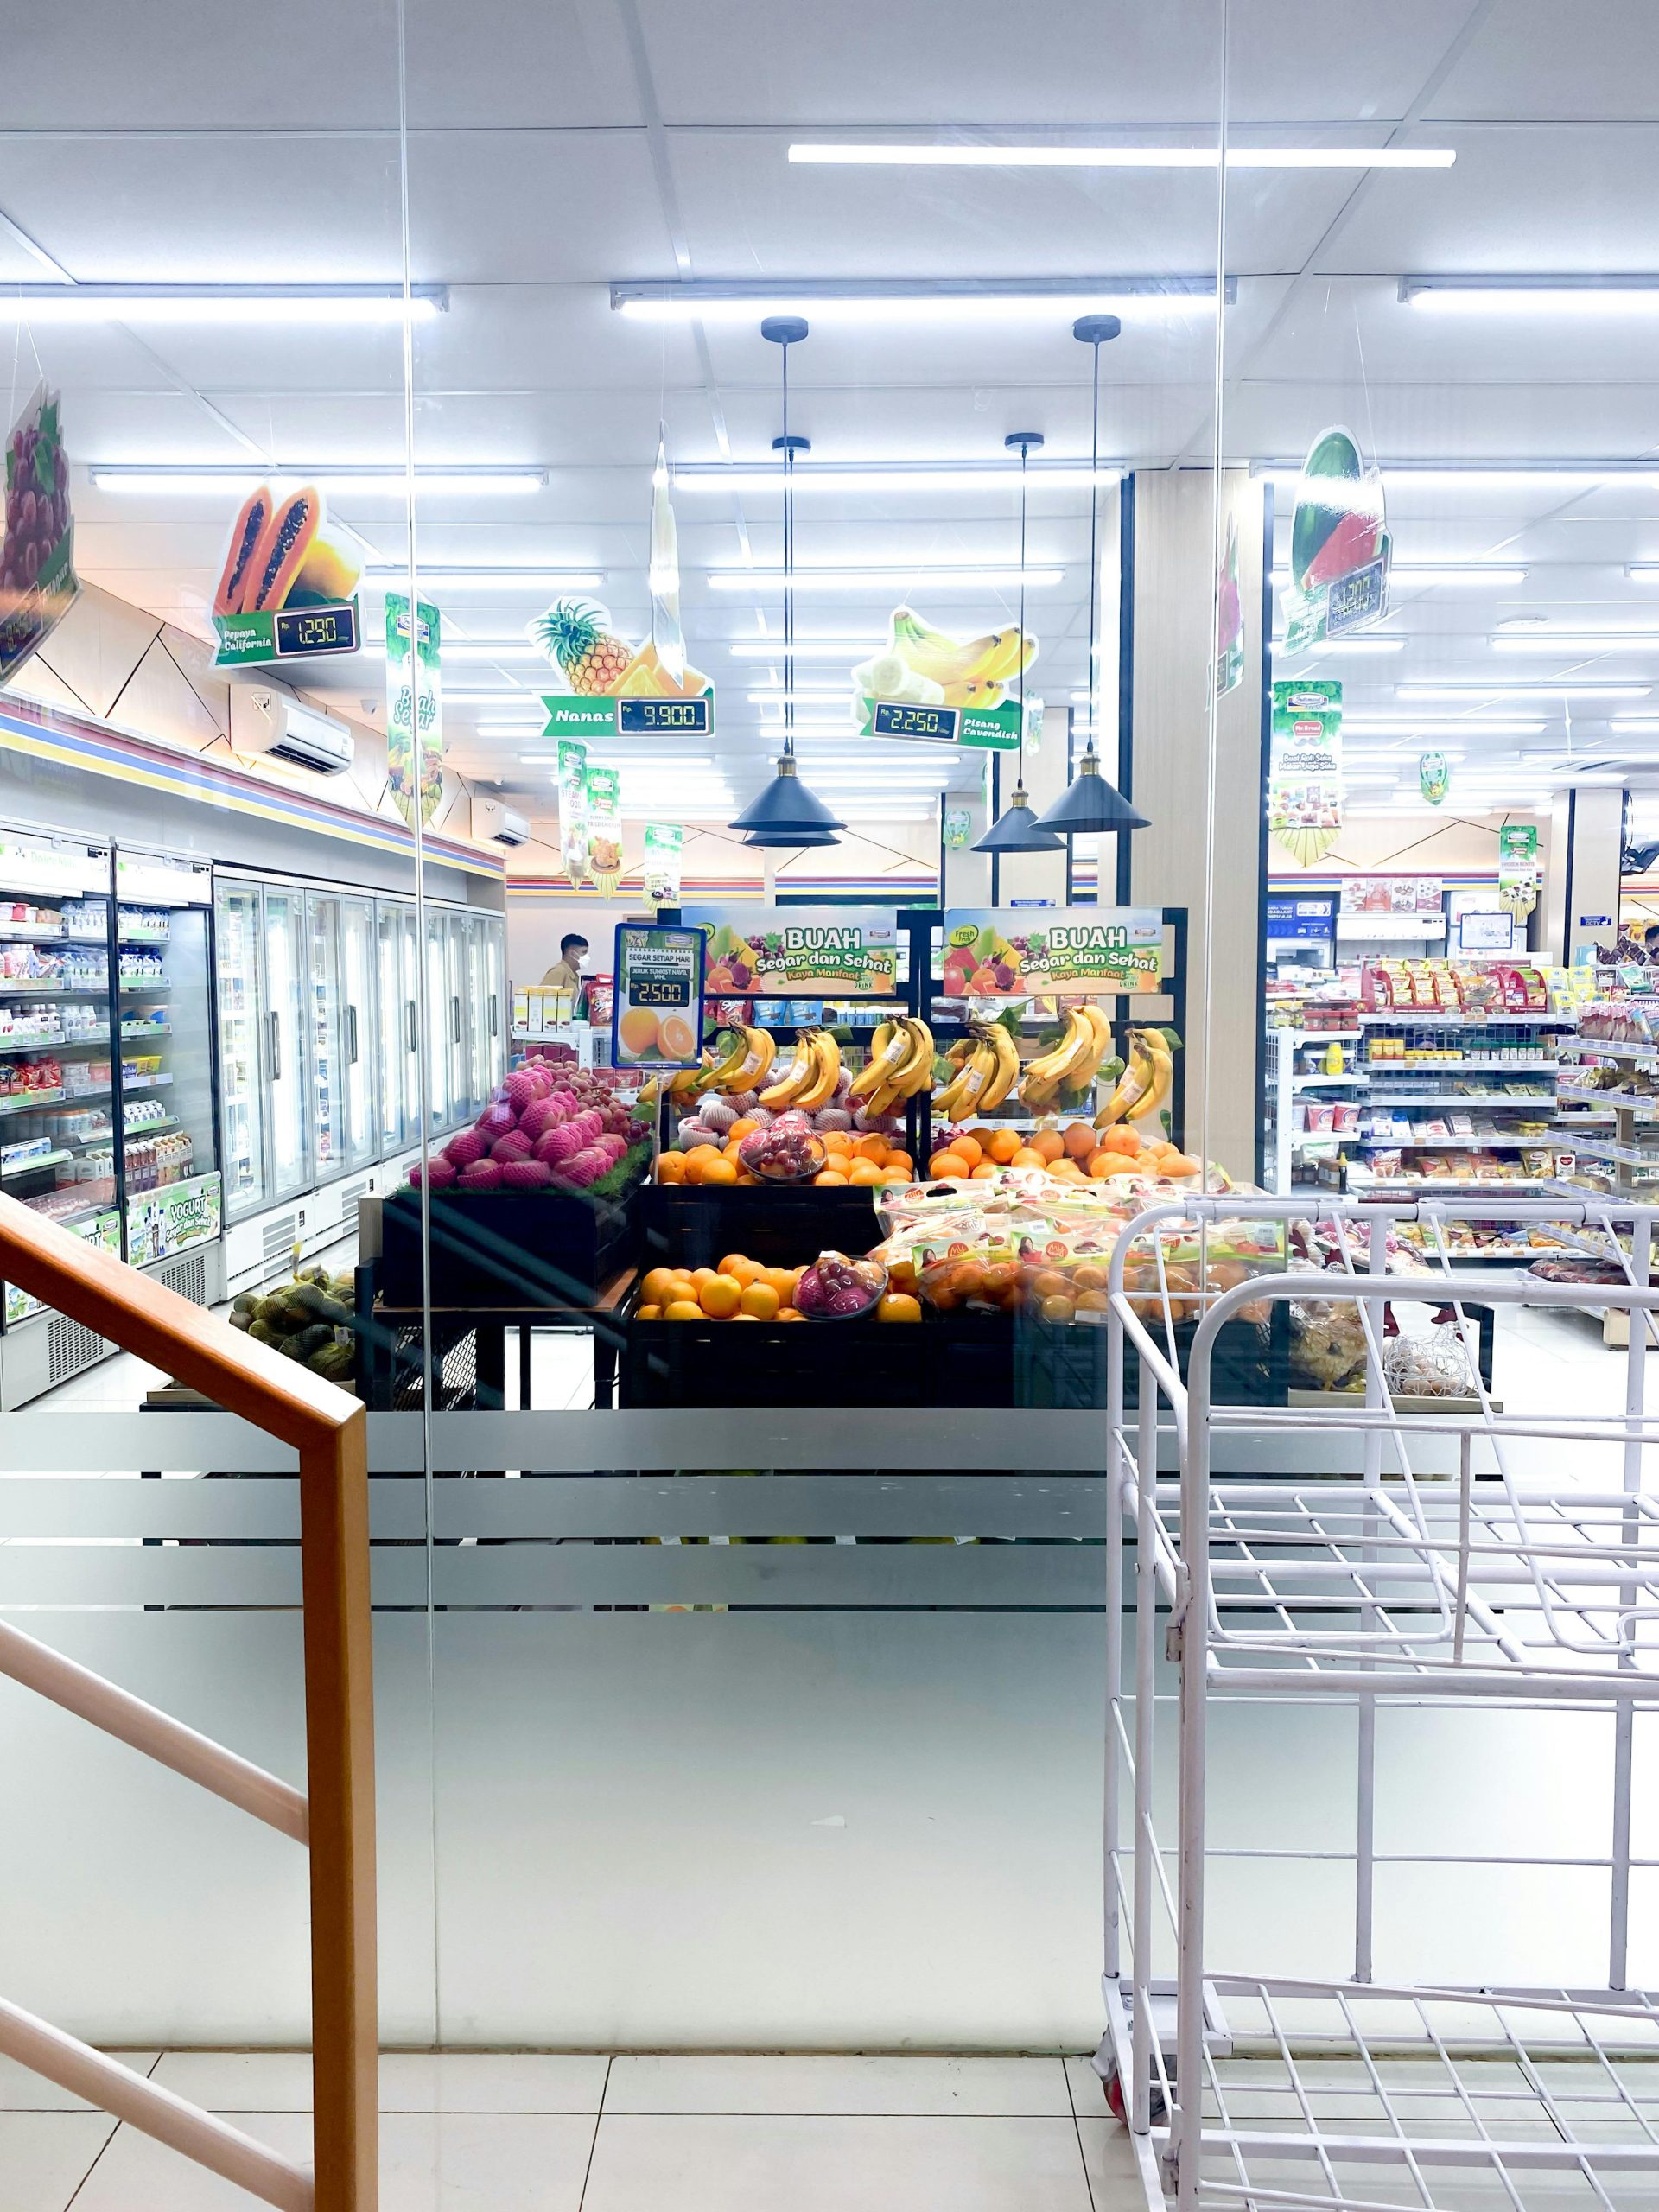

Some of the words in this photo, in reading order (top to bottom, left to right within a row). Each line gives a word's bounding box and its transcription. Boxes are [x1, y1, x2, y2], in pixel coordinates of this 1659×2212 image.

[298, 617, 337, 644] 1.290
[225, 638, 272, 652] California
[401, 685, 435, 715] Bah
[556, 710, 614, 722] Nanas
[644, 705, 696, 726] 9.900
[891, 709, 939, 733] 2.250
[963, 718, 1001, 730] Pisang
[963, 728, 1018, 741] Cavendish
[786, 928, 861, 950] BUAH
[1051, 927, 1126, 950] BUAH
[758, 954, 805, 973] Segar
[809, 952, 841, 966] dan
[843, 953, 892, 974] Sehat
[1020, 953, 1071, 973] Segar
[1073, 950, 1106, 966] dan
[1108, 951, 1157, 972] Sehat
[787, 969, 813, 981] Kaya
[816, 969, 861, 981] Manfaat
[1051, 969, 1078, 981] Kaya
[1080, 968, 1124, 980] Manfaat
[639, 982, 681, 1001] 2.500
[170, 1196, 206, 1222] YOGURT
[166, 1224, 183, 1243] Segar
[183, 1218, 194, 1229] dan
[194, 1214, 211, 1228] Sehat
